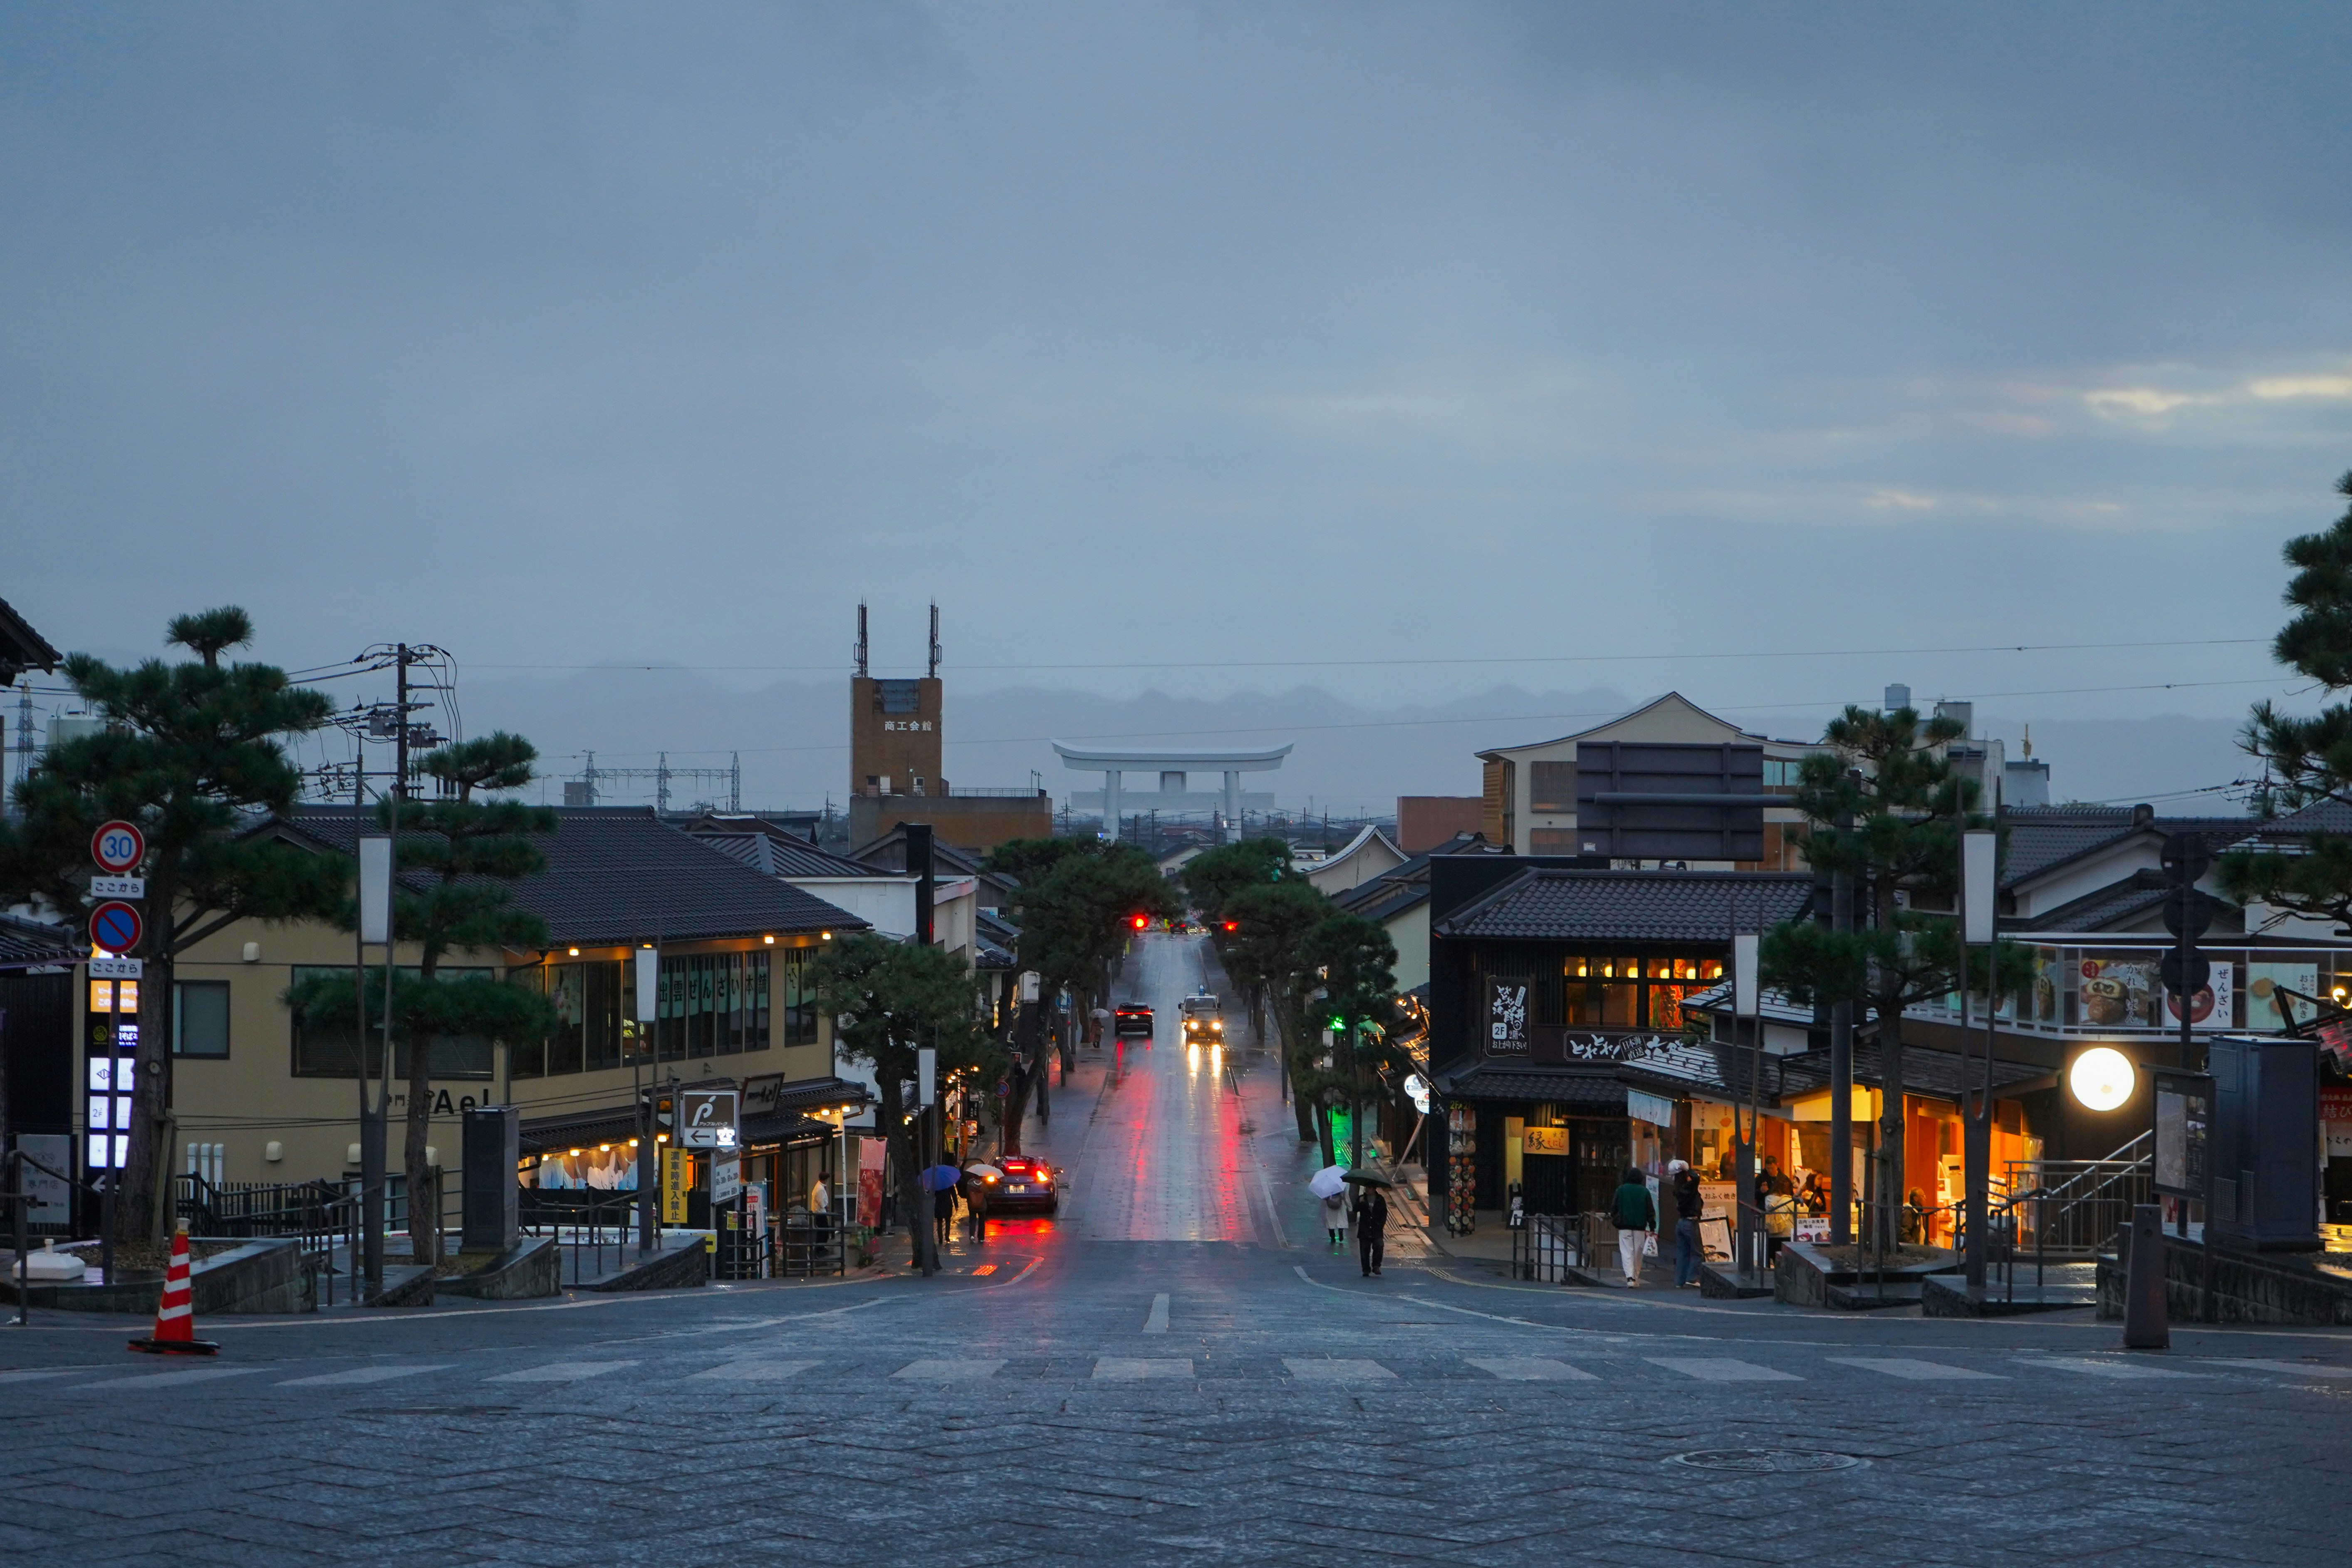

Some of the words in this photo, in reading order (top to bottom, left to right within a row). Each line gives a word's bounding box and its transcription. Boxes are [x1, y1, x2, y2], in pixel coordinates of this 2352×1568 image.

[885, 720, 932, 731] 商工会館
[104, 836, 132, 858] 30
[96, 882, 139, 893] ここから
[94, 963, 137, 973] ここから
[2218, 969, 2228, 1018] ぜんざい
[2300, 974, 2308, 1018] おふ焼き
[1495, 1026, 1505, 1035] 2F
[671, 1151, 679, 1220] 満車時進入禁止
